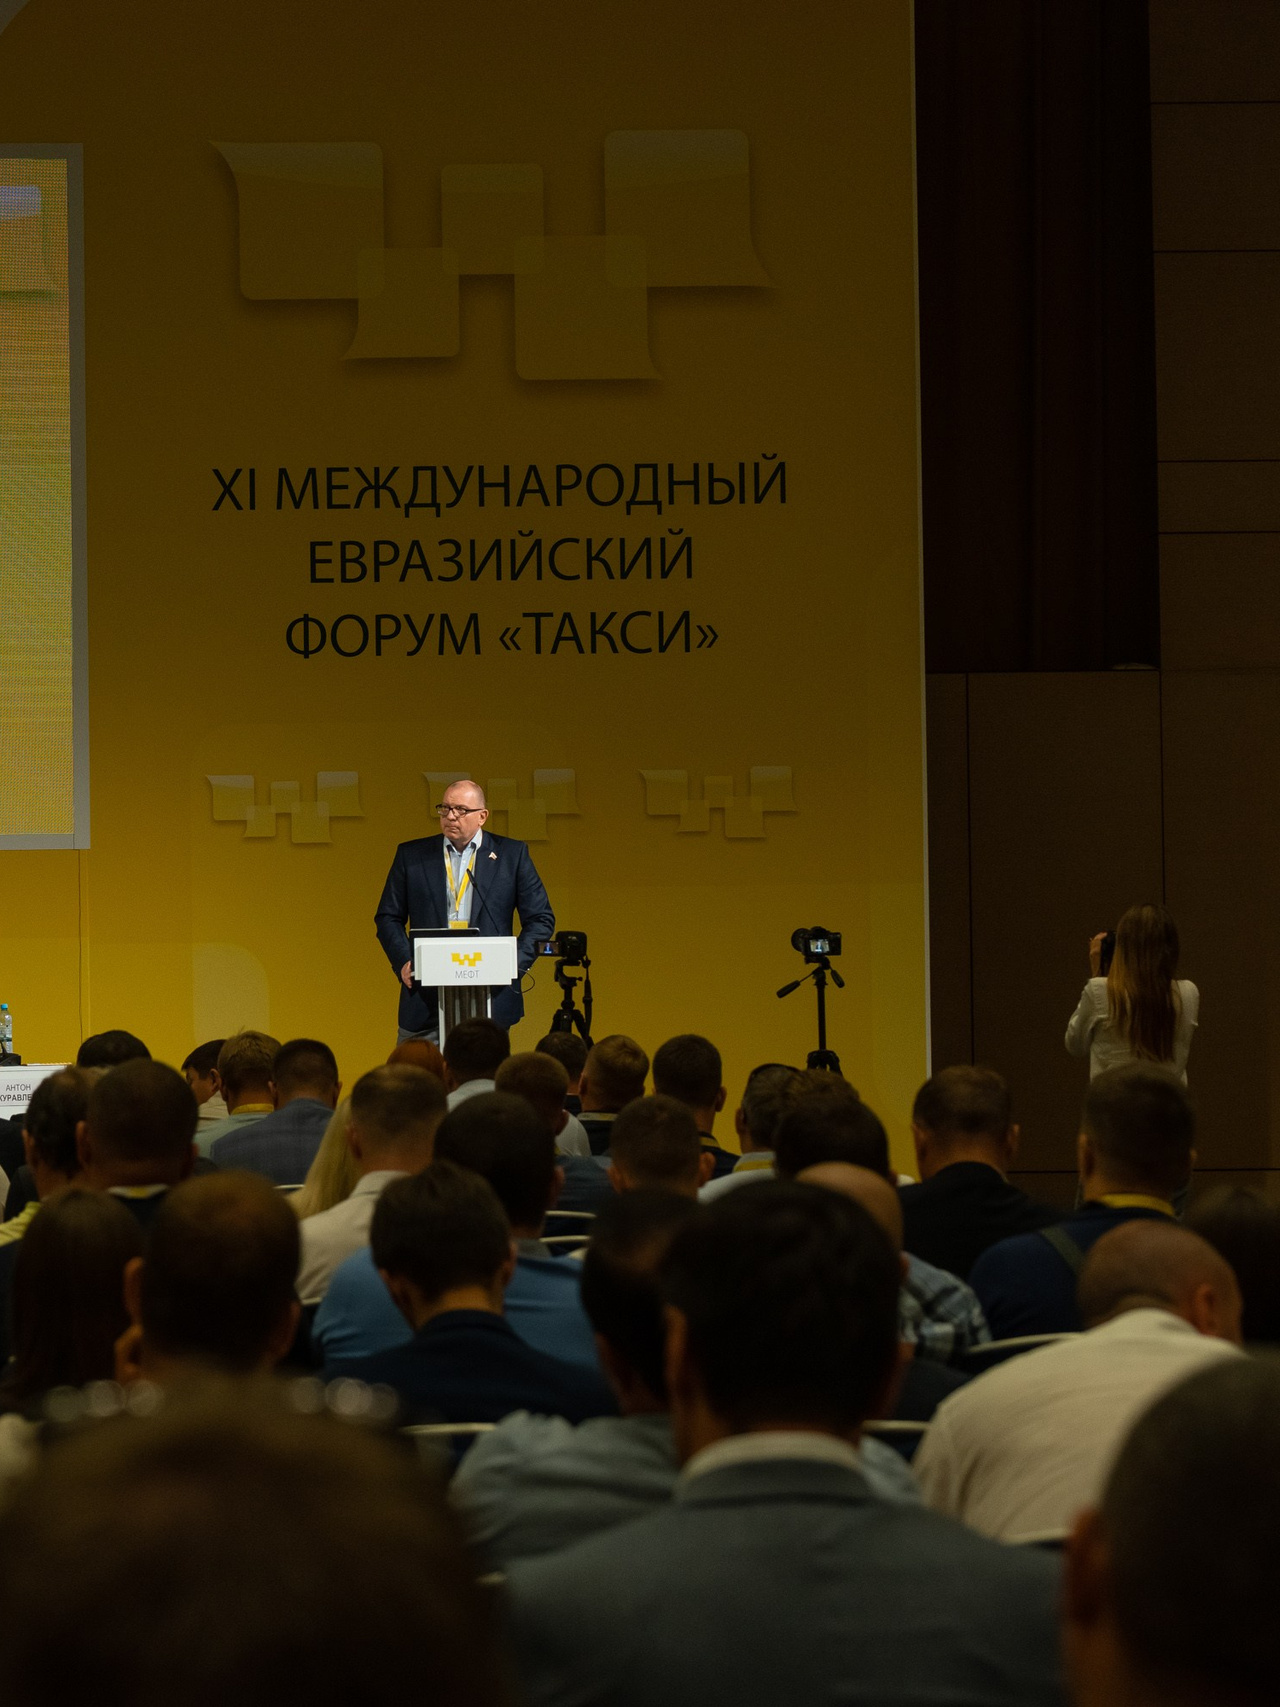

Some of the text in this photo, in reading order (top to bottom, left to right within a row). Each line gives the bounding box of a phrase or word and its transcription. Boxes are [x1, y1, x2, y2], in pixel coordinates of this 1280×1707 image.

[276, 453, 788, 519] МЕЖДУНАРОДНЫЙ
[309, 527, 694, 584] ЕВРАЗИЙСКИЙ
[285, 610, 719, 660] ФОРУМ «ТАКСИ»
[454, 969, 480, 979] МЕФТ
[5, 1083, 32, 1091] АНТОН
